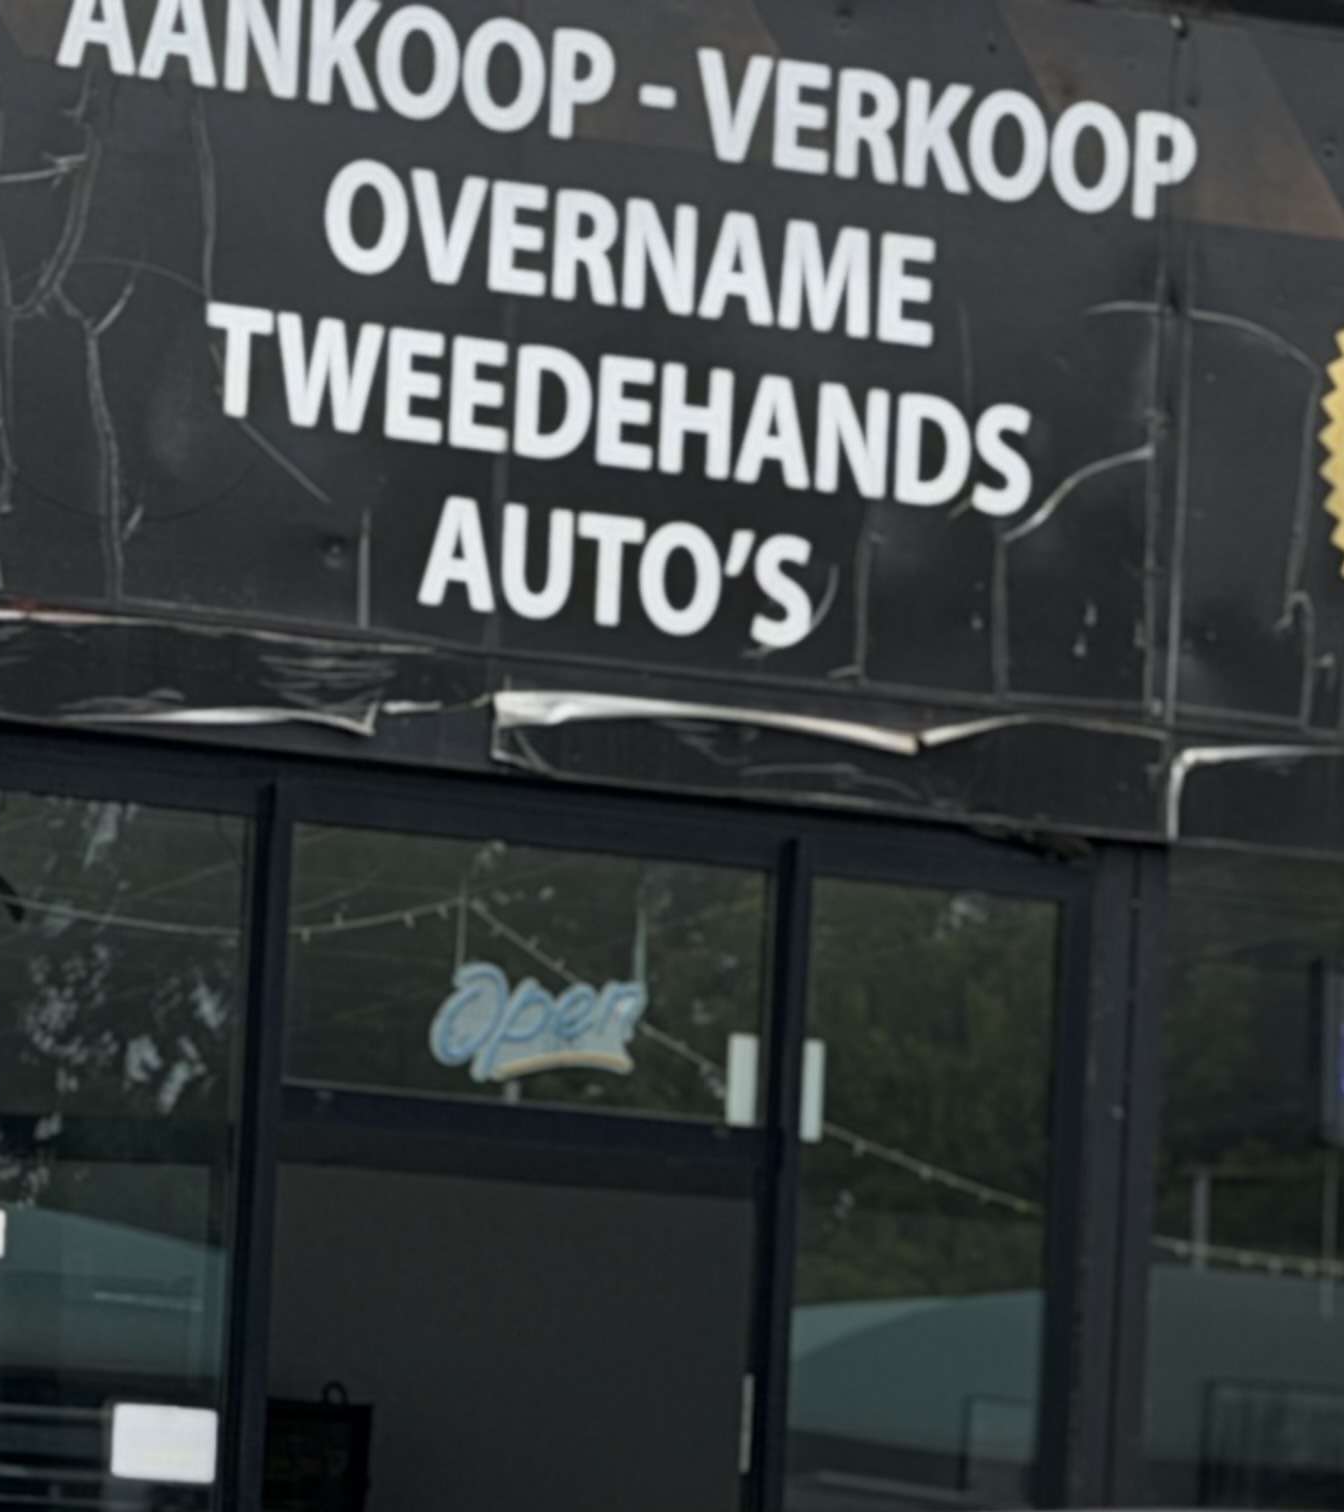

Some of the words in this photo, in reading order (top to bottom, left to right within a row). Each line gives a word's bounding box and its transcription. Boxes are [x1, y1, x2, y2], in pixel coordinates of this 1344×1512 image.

[57, 0, 616, 139] AANKOOP
[697, 47, 1198, 220] VERKOOP
[324, 159, 936, 349] OVERNAME
[206, 300, 1034, 518] TWEEDEHANDS
[416, 495, 813, 649] AUTO'S
[434, 964, 644, 1081] Open
